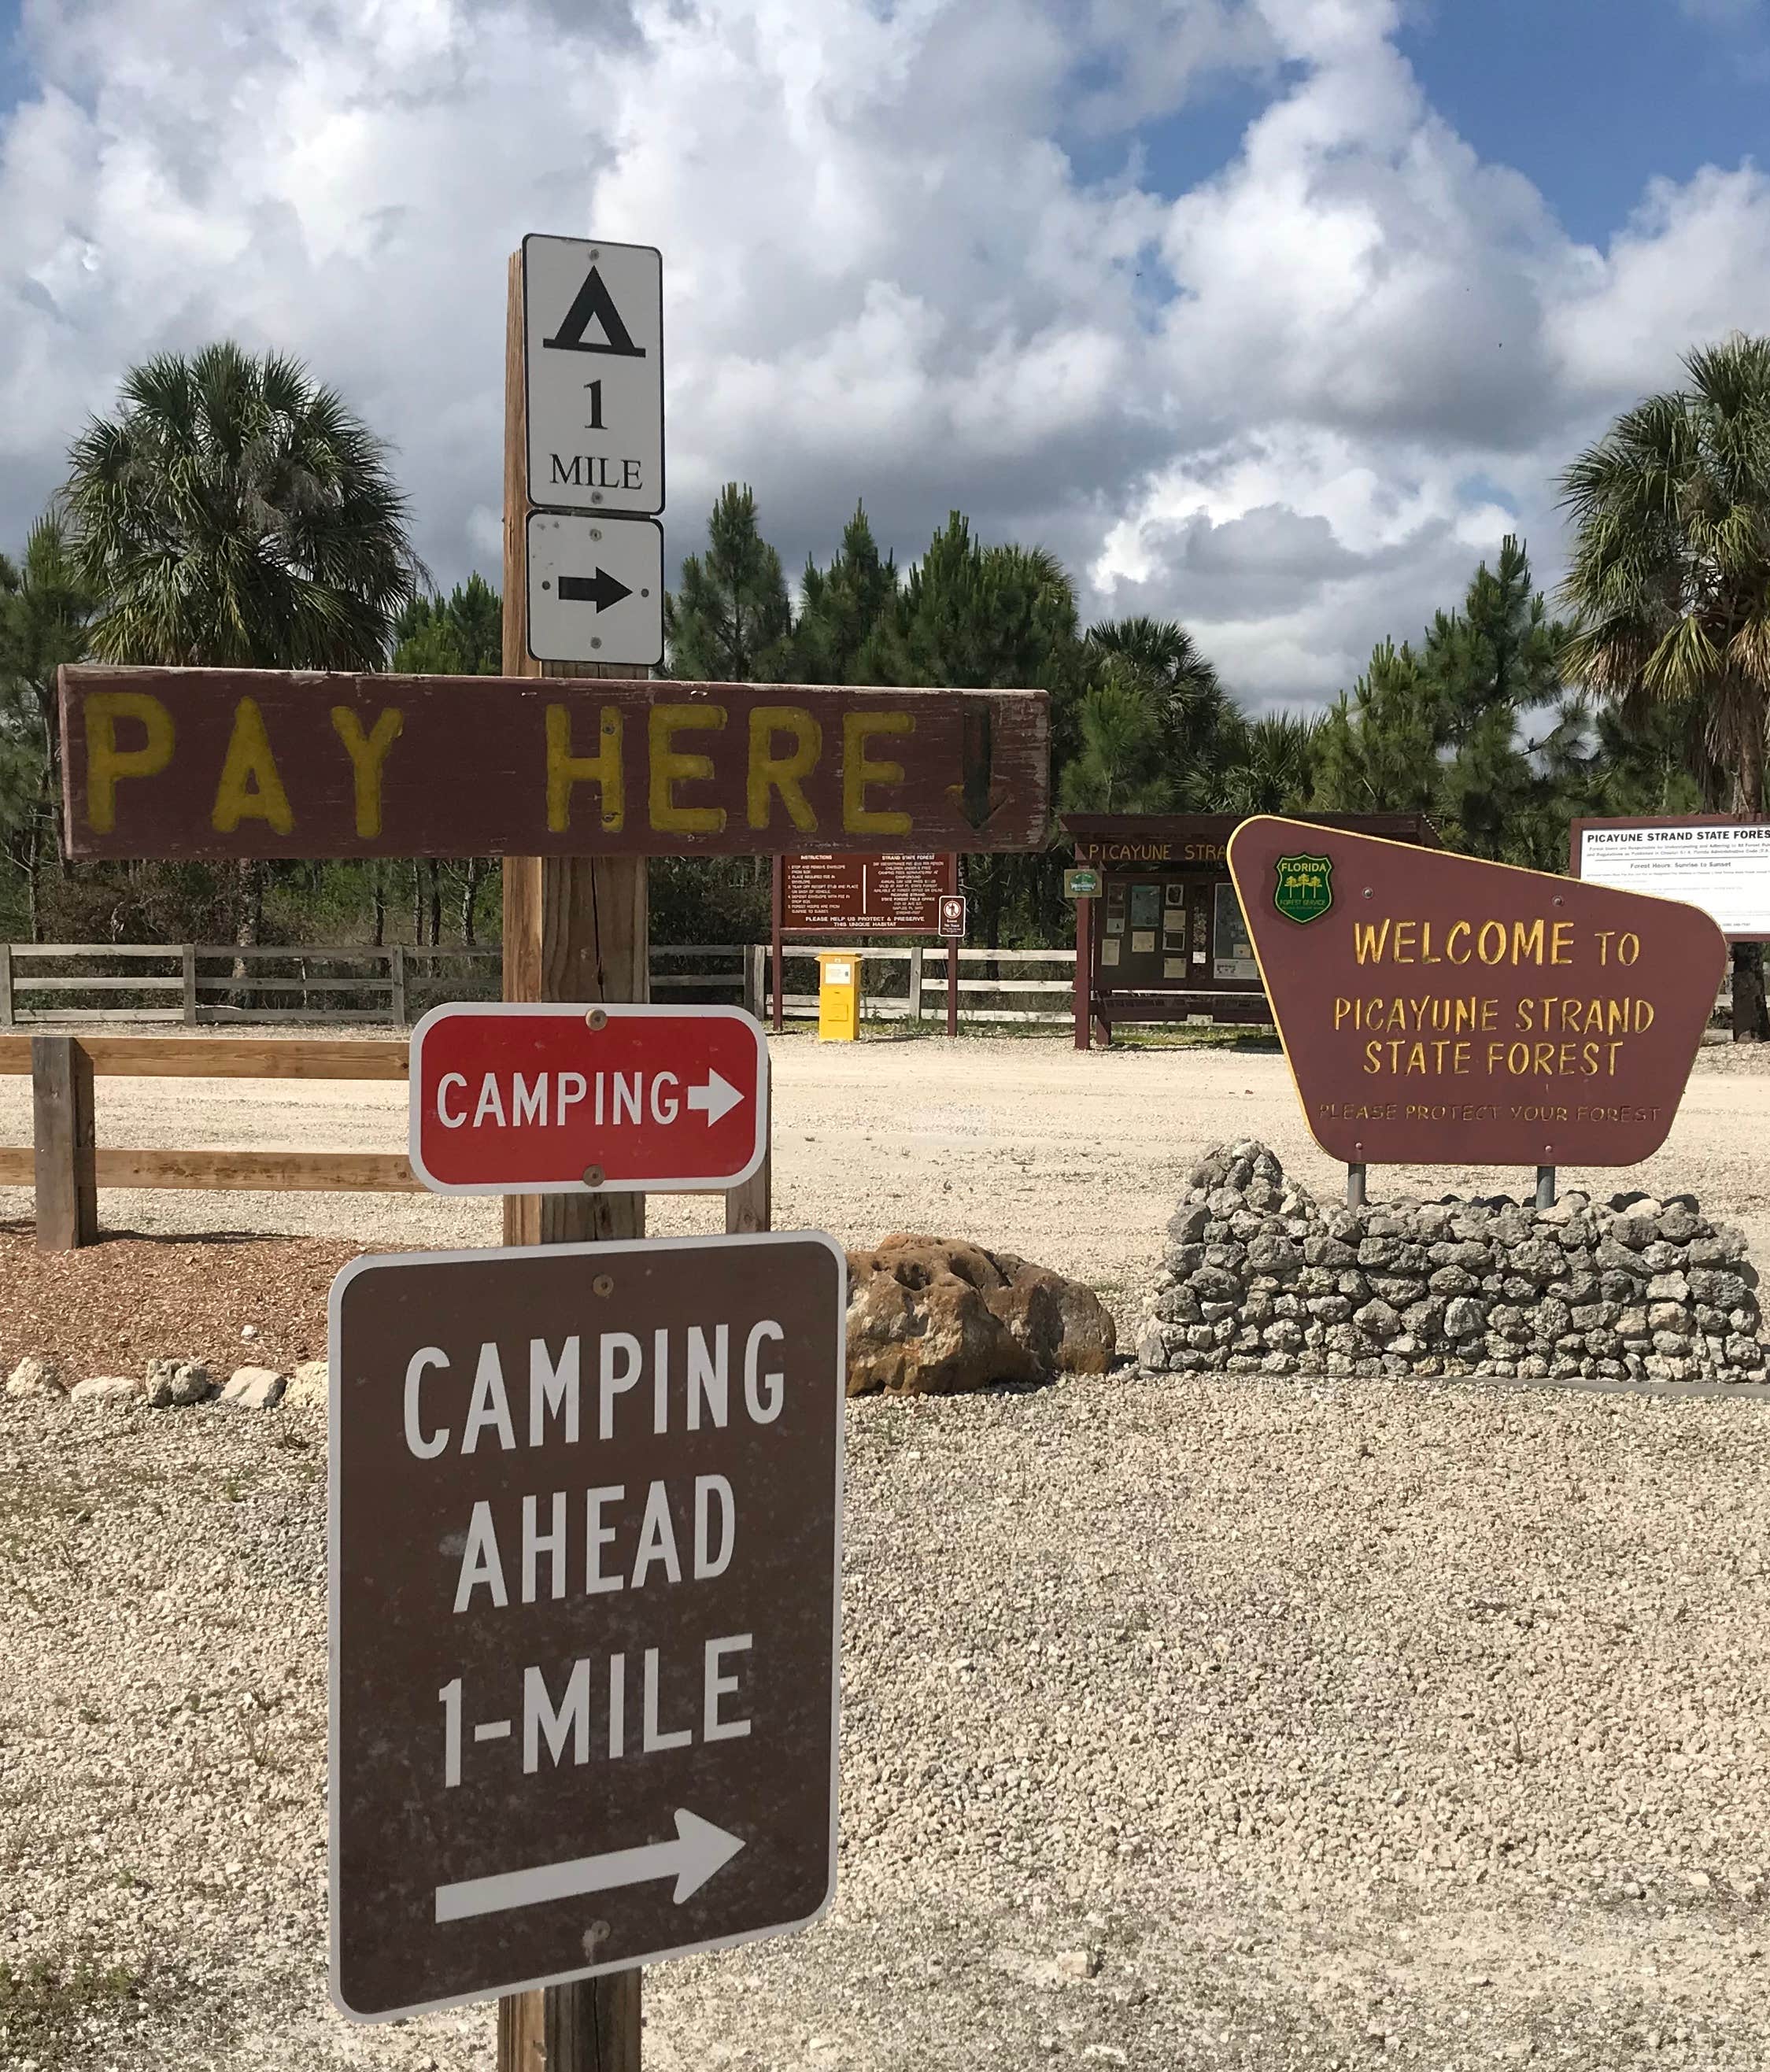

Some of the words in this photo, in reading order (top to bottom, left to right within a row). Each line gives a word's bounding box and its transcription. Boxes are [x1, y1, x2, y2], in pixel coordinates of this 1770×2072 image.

[584, 379, 608, 430] 1
[549, 453, 643, 490] MILE
[83, 691, 405, 840] PAY
[545, 703, 916, 837] HERE
[1089, 844, 1171, 859] PICAYUNE
[1587, 833, 1643, 842] PICAYUNE
[1647, 832, 1692, 841] STRAND
[1697, 831, 1730, 840] STATE
[1281, 862, 1327, 872] FLORIDA
[1354, 918, 1576, 966] WELCOME
[1594, 931, 1640, 966] TO
[1334, 995, 1498, 1035] PICAYUNE
[1515, 997, 1655, 1035] STRAND
[1363, 1040, 1471, 1076] STATE
[1487, 1041, 1624, 1077] FOREST
[438, 1072, 680, 1128] CAMPING
[1319, 1103, 1397, 1121] PLEASE
[1405, 1104, 1500, 1121] PROTECT
[1510, 1106, 1568, 1121] YOUR
[1576, 1106, 1661, 1122] FOREST
[403, 1319, 785, 1460] CAMPING
[453, 1473, 737, 1613] AHEAD
[438, 1633, 754, 1789] 1-MILE
